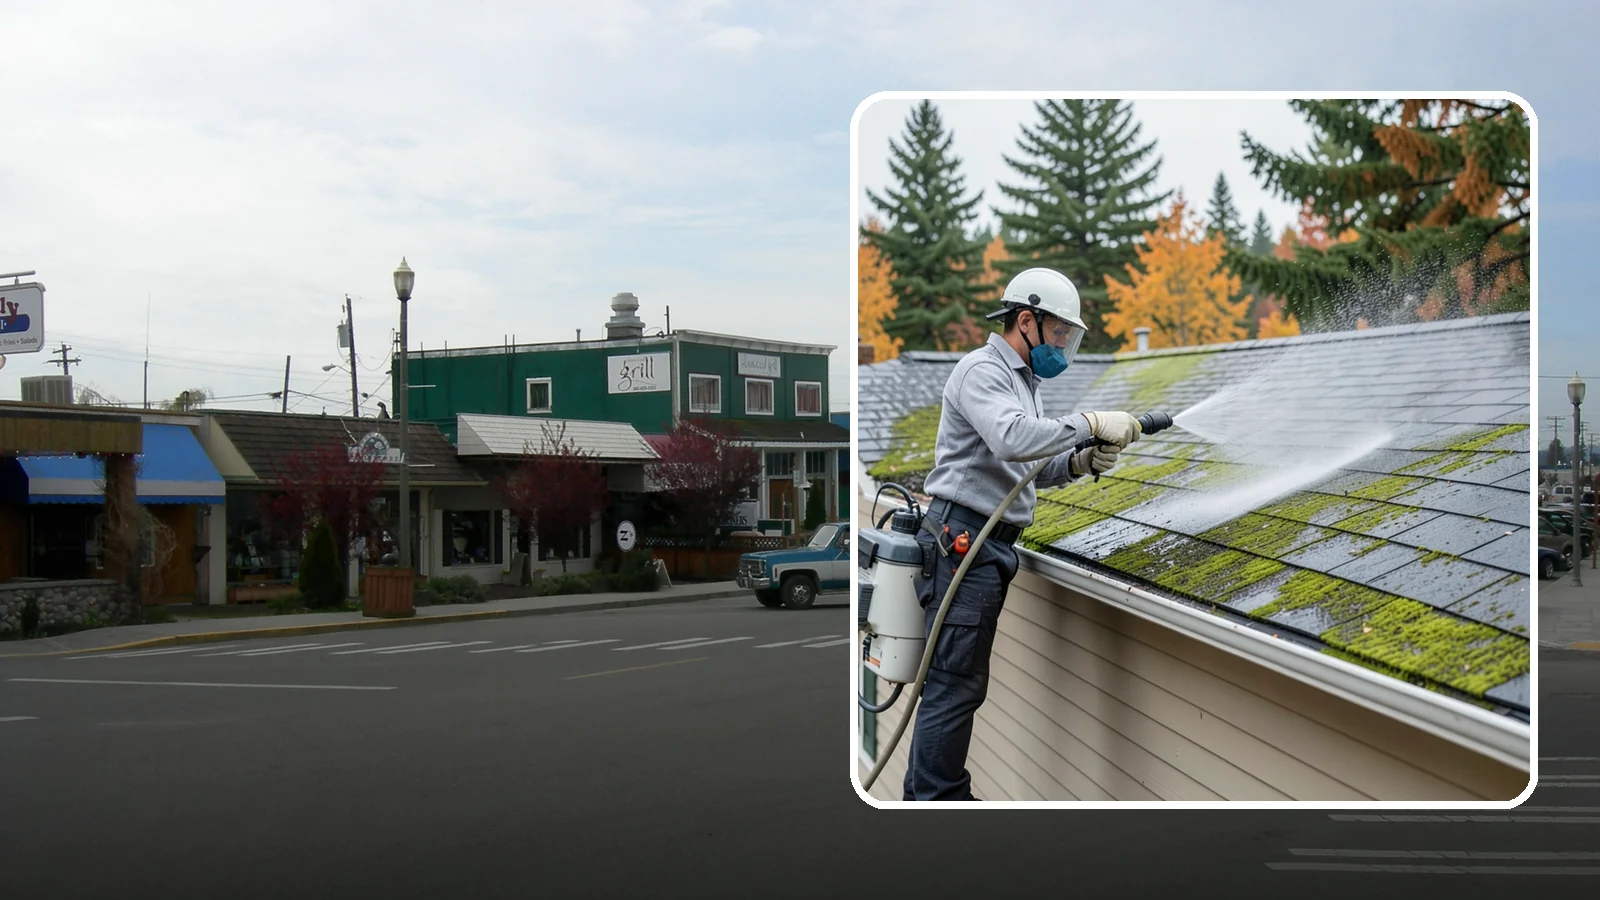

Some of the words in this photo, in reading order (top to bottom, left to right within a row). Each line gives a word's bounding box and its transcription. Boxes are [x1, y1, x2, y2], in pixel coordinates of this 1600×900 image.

[3, 338, 16, 346] Fries
[20, 336, 38, 345] Salads
[617, 356, 655, 391] grill
